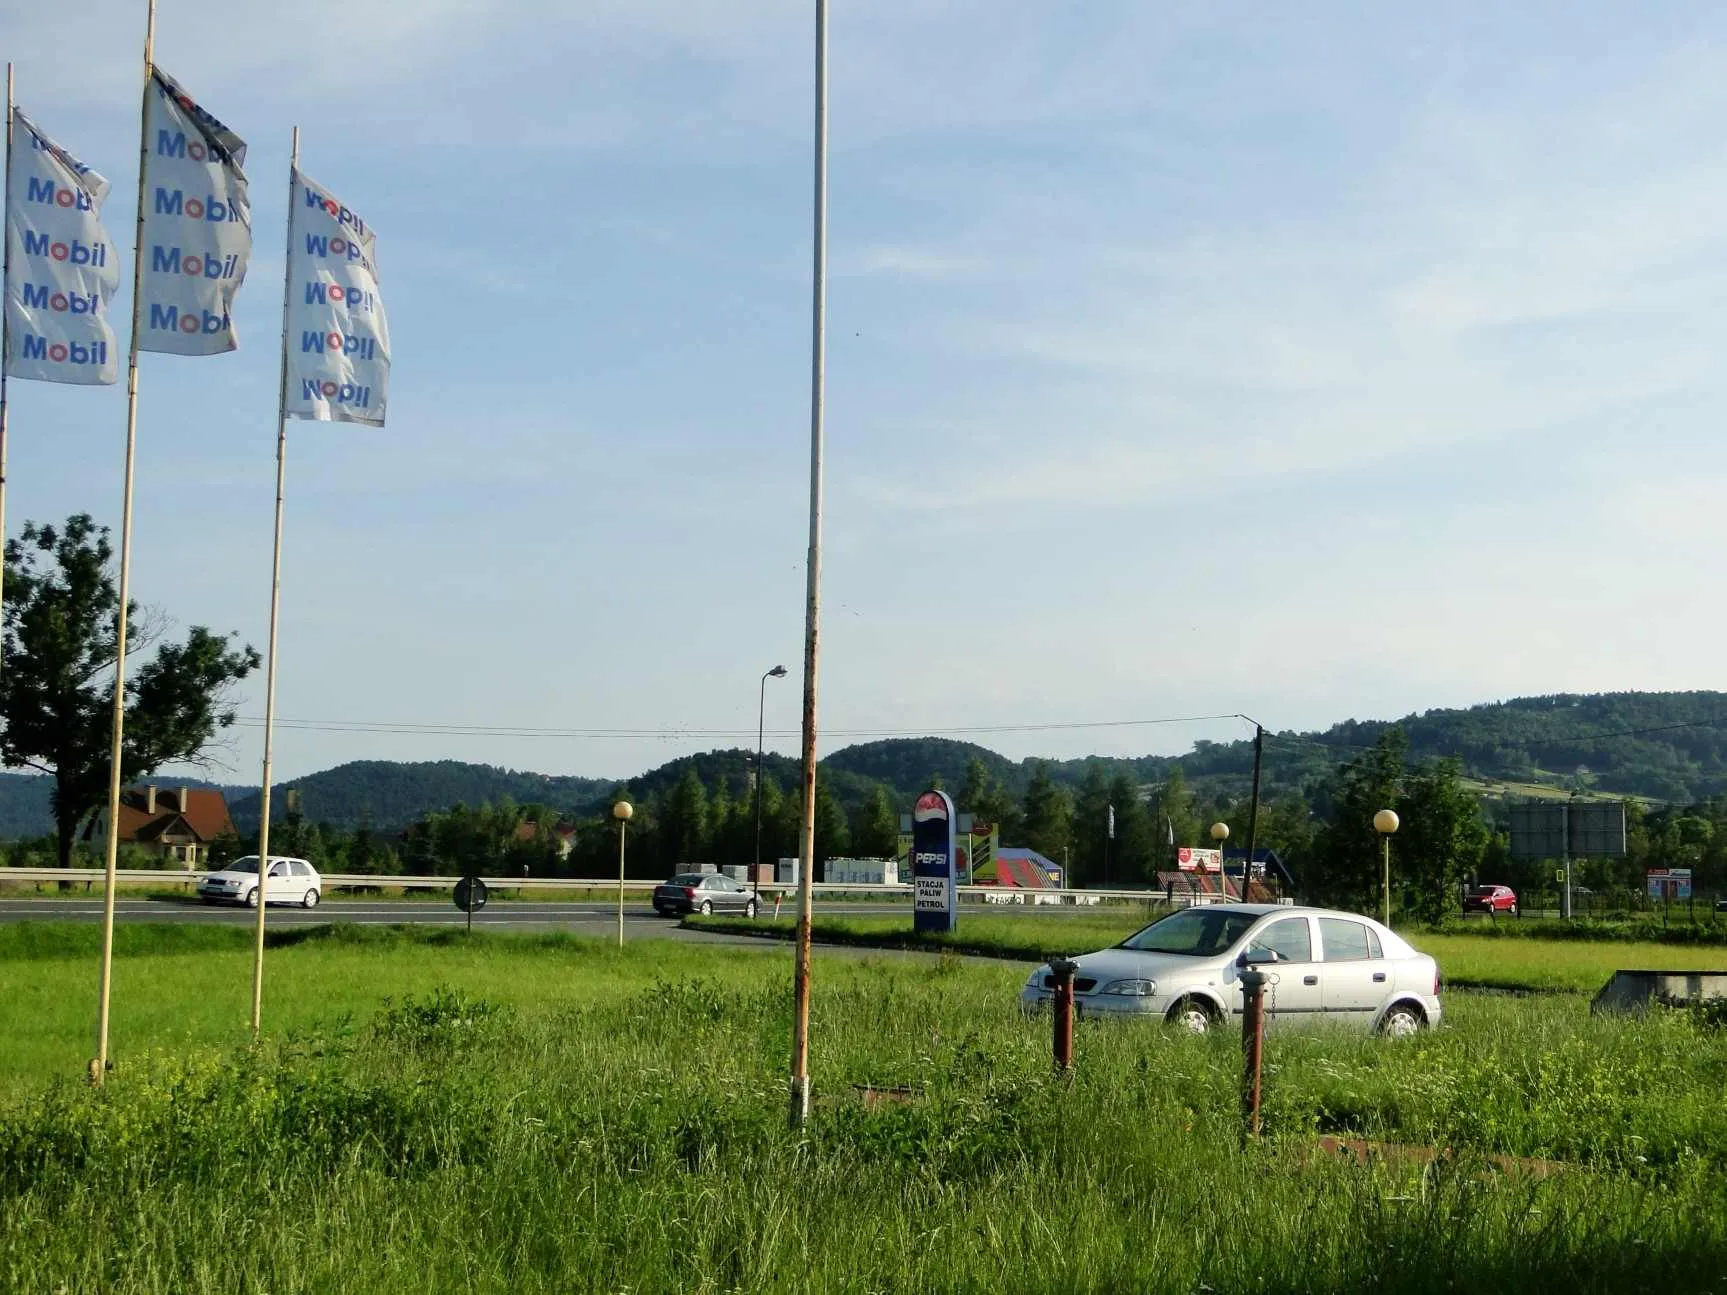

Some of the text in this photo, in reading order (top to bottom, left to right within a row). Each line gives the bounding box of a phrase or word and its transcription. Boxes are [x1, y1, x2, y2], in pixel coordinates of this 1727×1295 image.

[24, 230, 106, 267] Mobil
[153, 246, 239, 279] Mobil
[23, 334, 106, 365] Mobil
[915, 852, 947, 865] PEPSI
[917, 880, 944, 888] STACJA
[920, 889, 942, 897] PALIW
[917, 900, 944, 909] PETROL
